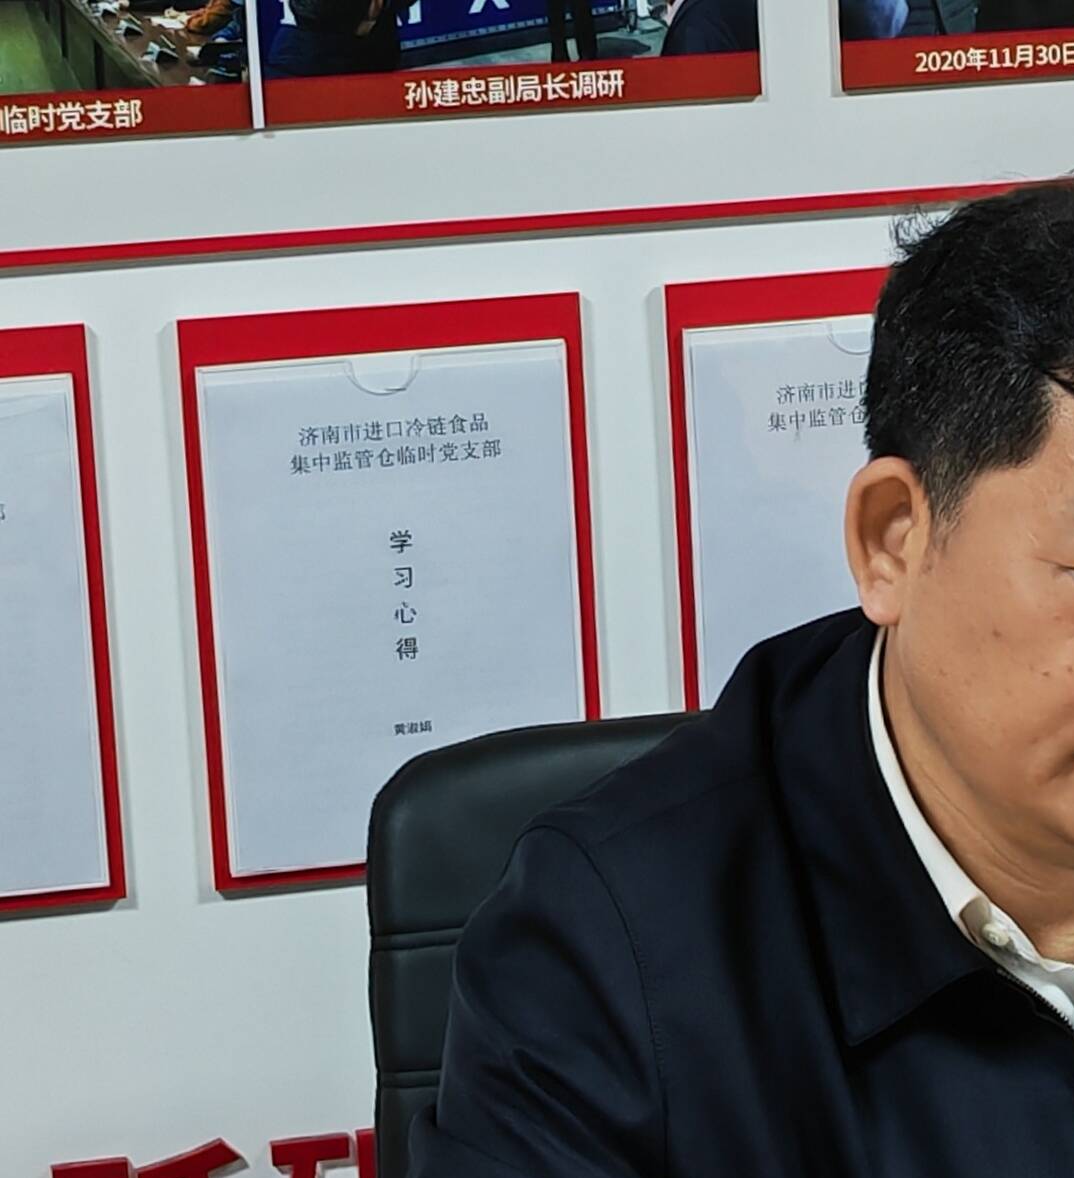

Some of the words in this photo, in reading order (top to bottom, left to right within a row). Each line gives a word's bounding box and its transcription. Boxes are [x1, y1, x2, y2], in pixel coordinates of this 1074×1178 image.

[404, 69, 625, 110] 孙建忠副局长调研
[0, 98, 143, 134] 临时党支部
[298, 413, 490, 446] 济南市进口冷链食品
[290, 439, 502, 476] 集中监管仓临时党支部
[389, 529, 419, 661] 学习心得
